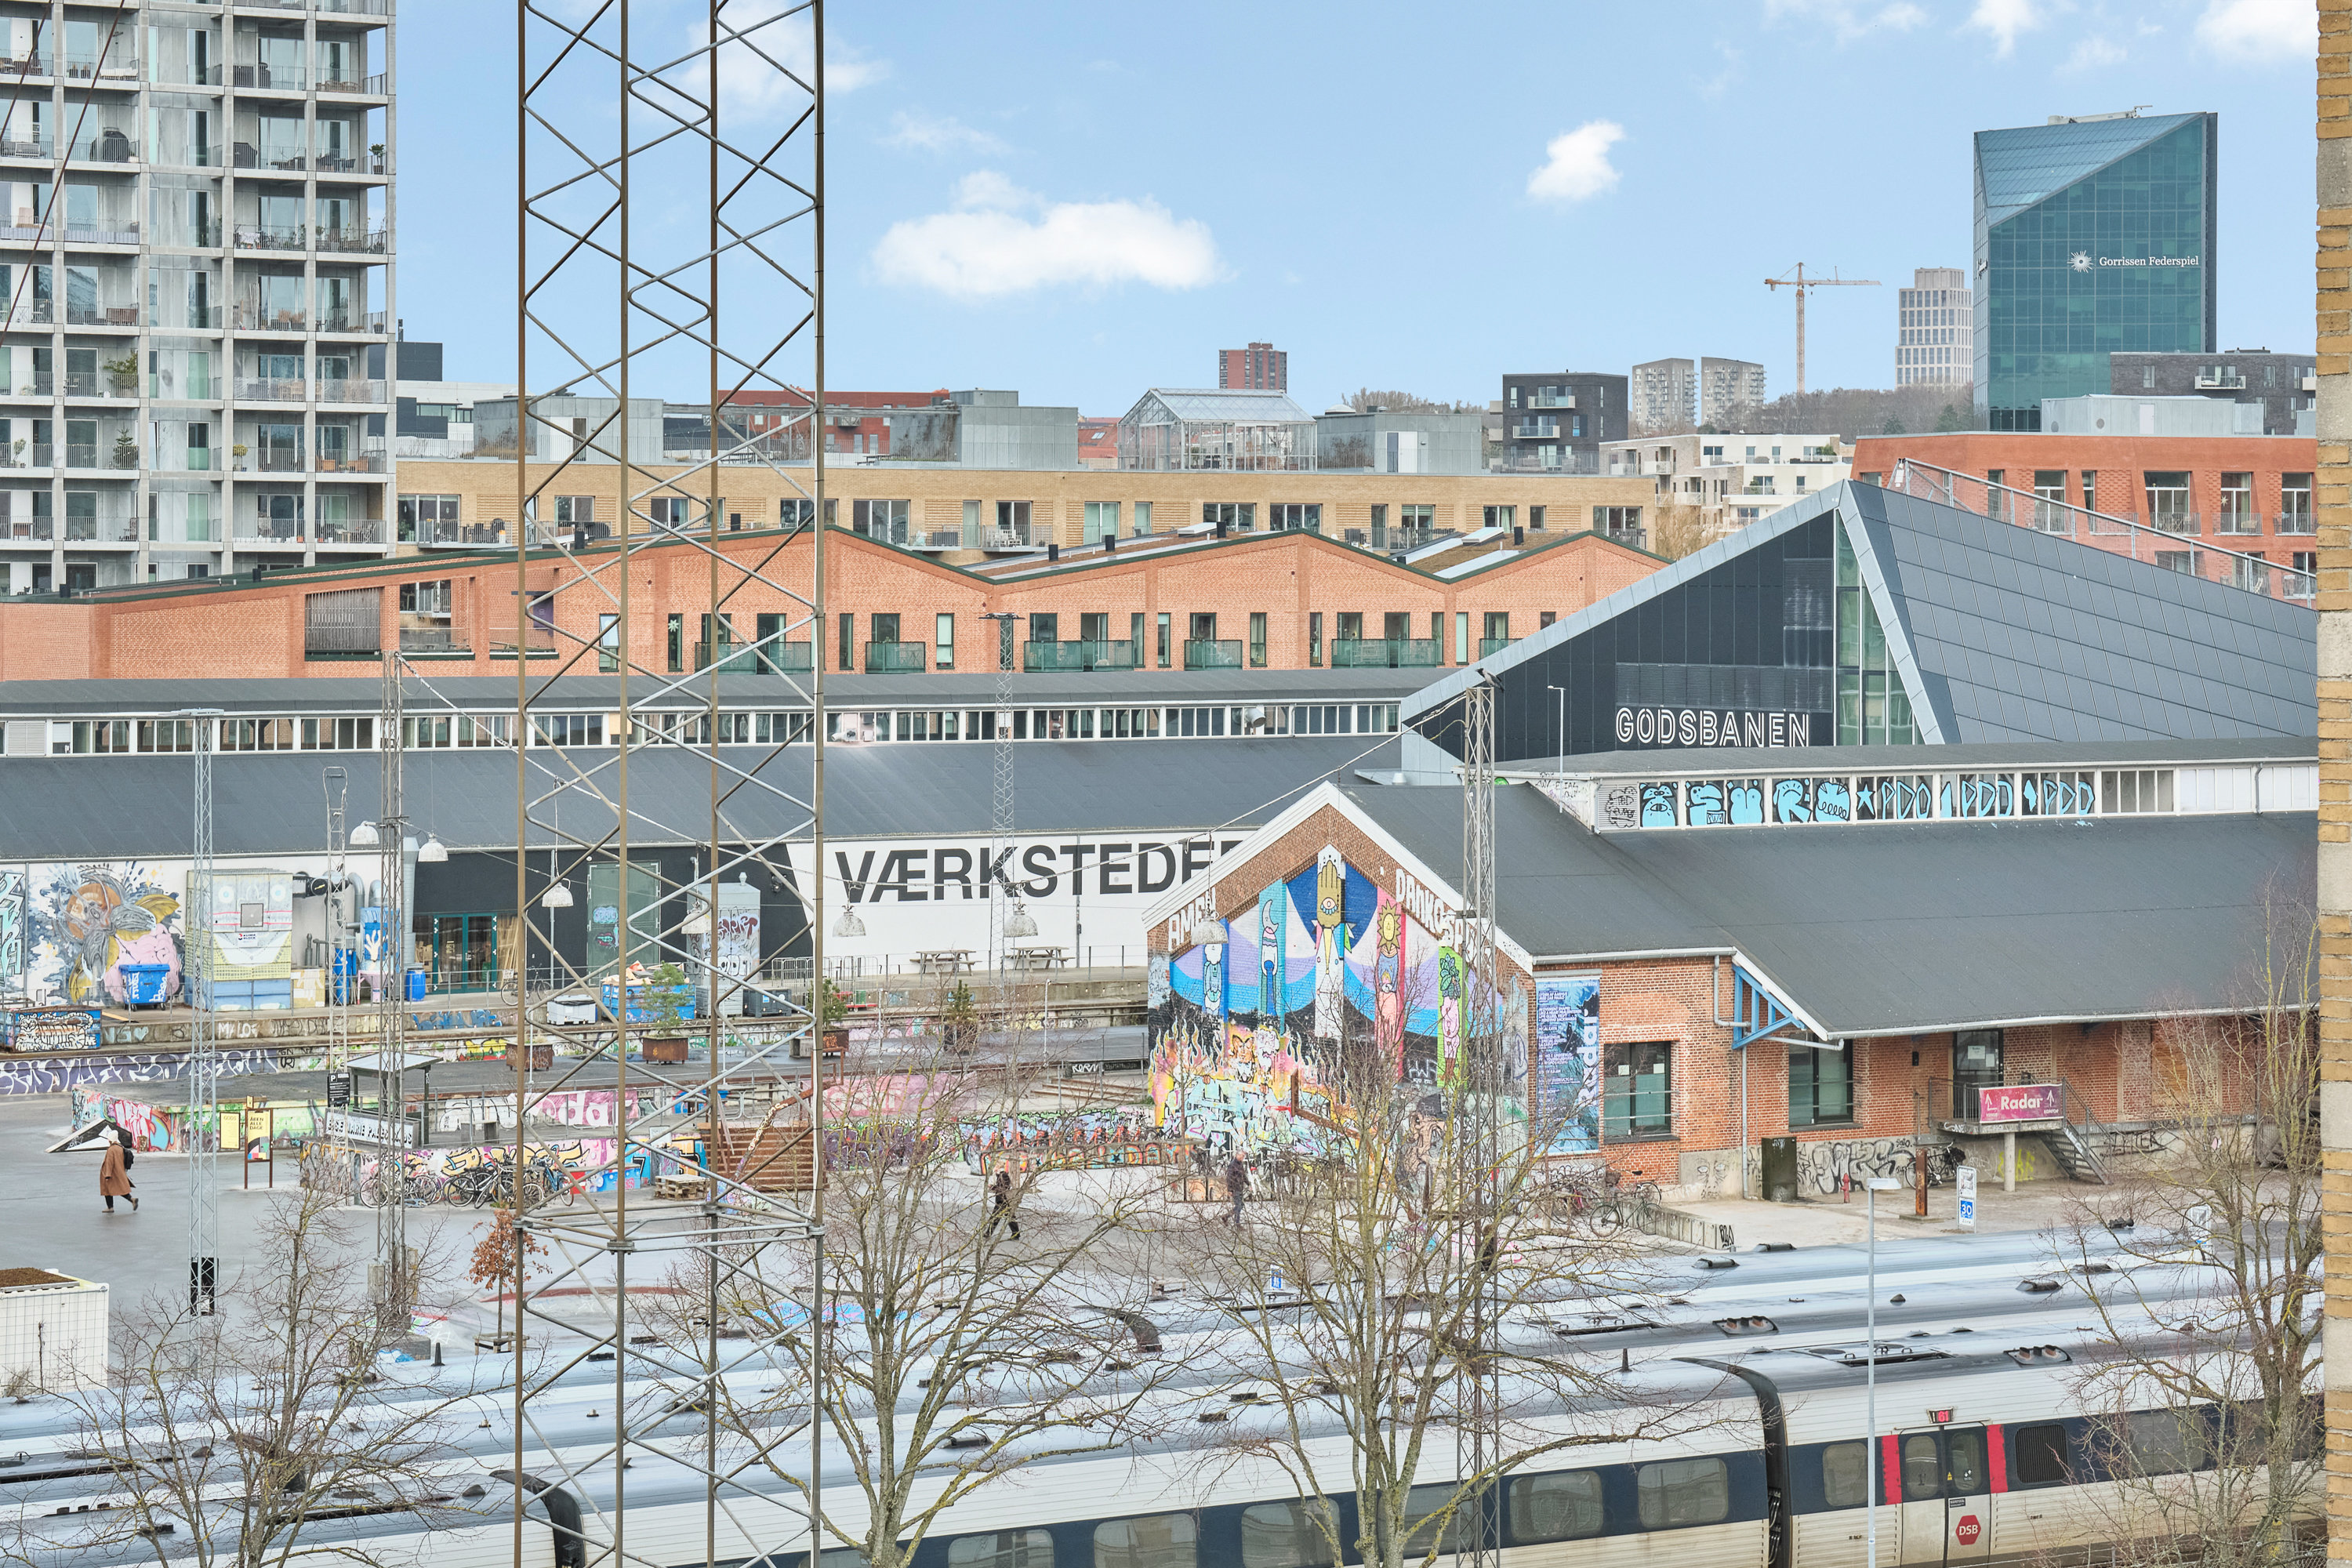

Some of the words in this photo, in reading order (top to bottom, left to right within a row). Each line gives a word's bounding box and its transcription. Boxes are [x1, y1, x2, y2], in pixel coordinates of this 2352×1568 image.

[2099, 256, 2147, 266] Gorrissen
[2148, 256, 2199, 267] Federspiel
[1616, 707, 1809, 748] GODSBANEN
[835, 840, 1243, 903] VÆRKSTEDE
[2001, 1094, 2044, 1110] Radar
[1961, 1204, 1972, 1214] 30
[1938, 1410, 1949, 1422] 61
[1958, 1525, 1978, 1536] DSB
